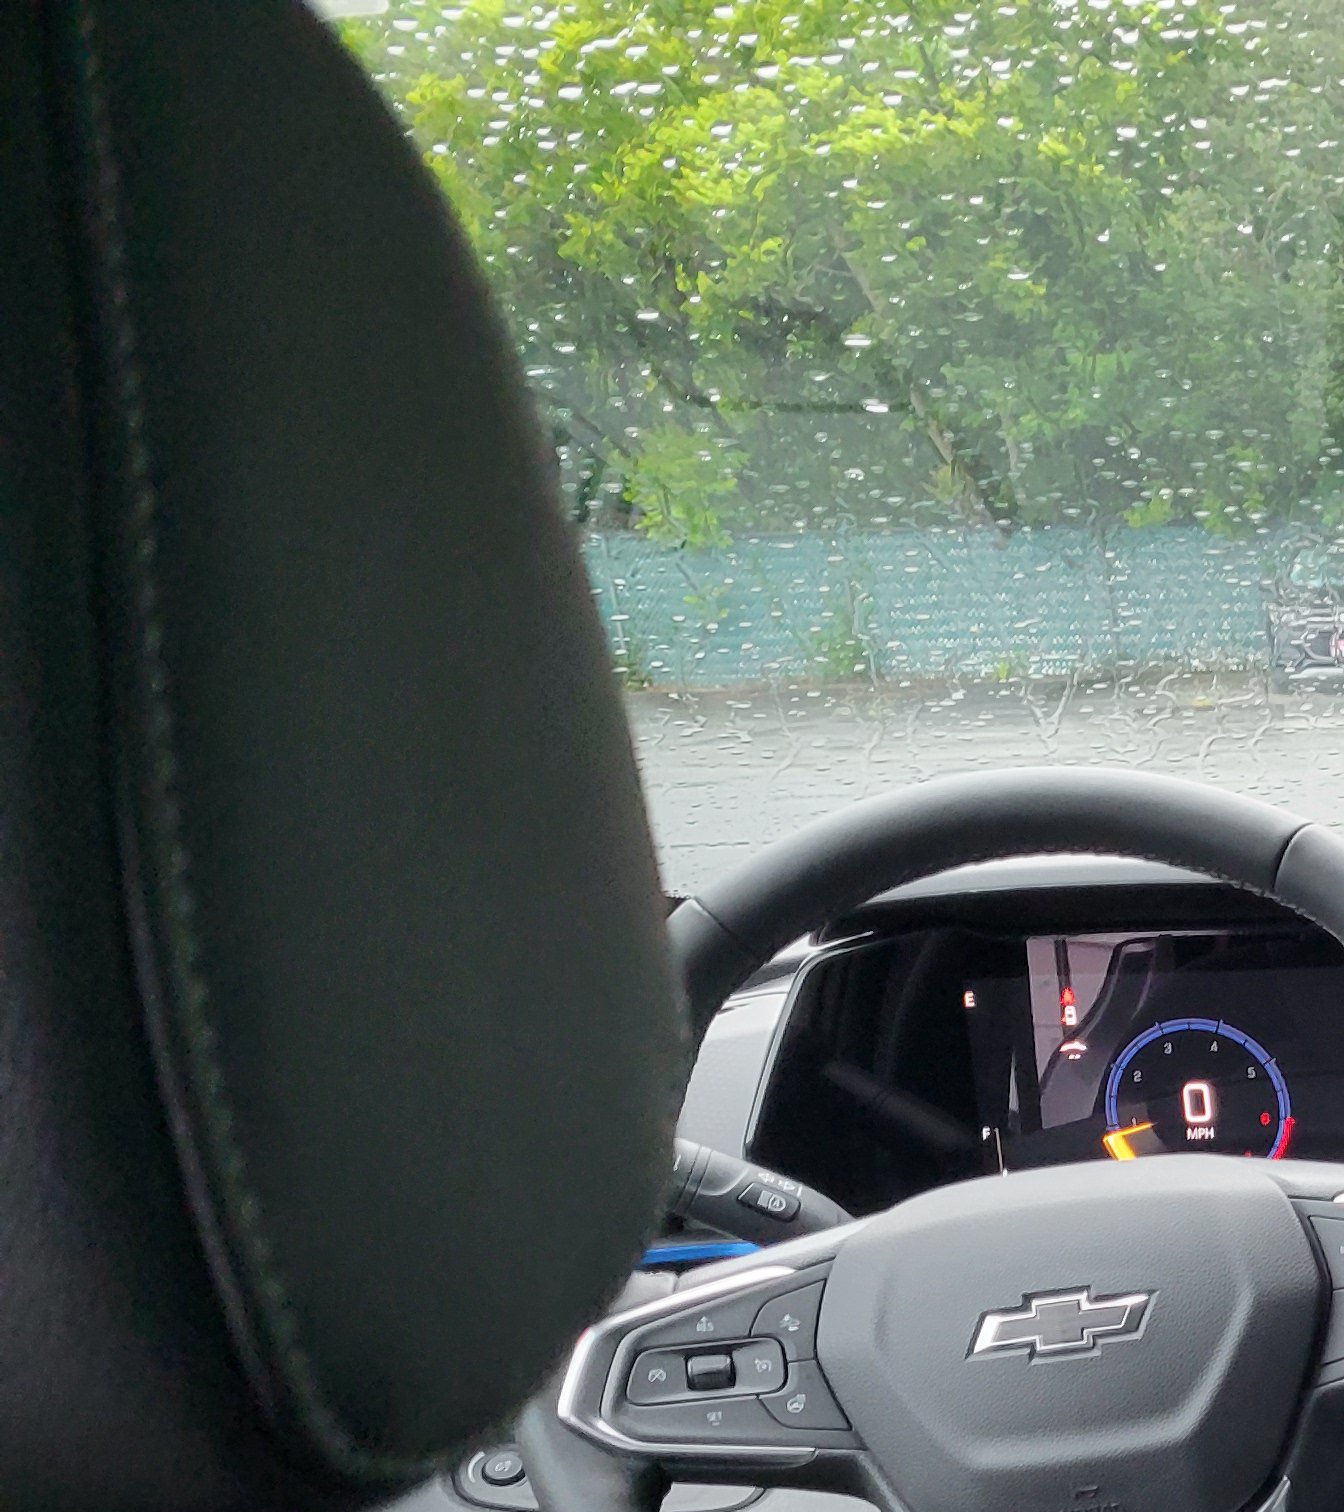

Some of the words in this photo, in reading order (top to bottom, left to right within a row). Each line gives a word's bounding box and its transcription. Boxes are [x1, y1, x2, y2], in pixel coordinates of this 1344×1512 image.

[964, 990, 975, 1007] E
[1164, 1042, 1172, 1054] 3
[1210, 1041, 1218, 1052] 4
[1133, 1070, 1142, 1082] 2
[1247, 1067, 1256, 1079] 5
[1183, 1083, 1212, 1123] 0
[982, 1126, 991, 1140] F
[1187, 1128, 1214, 1140] MPH
